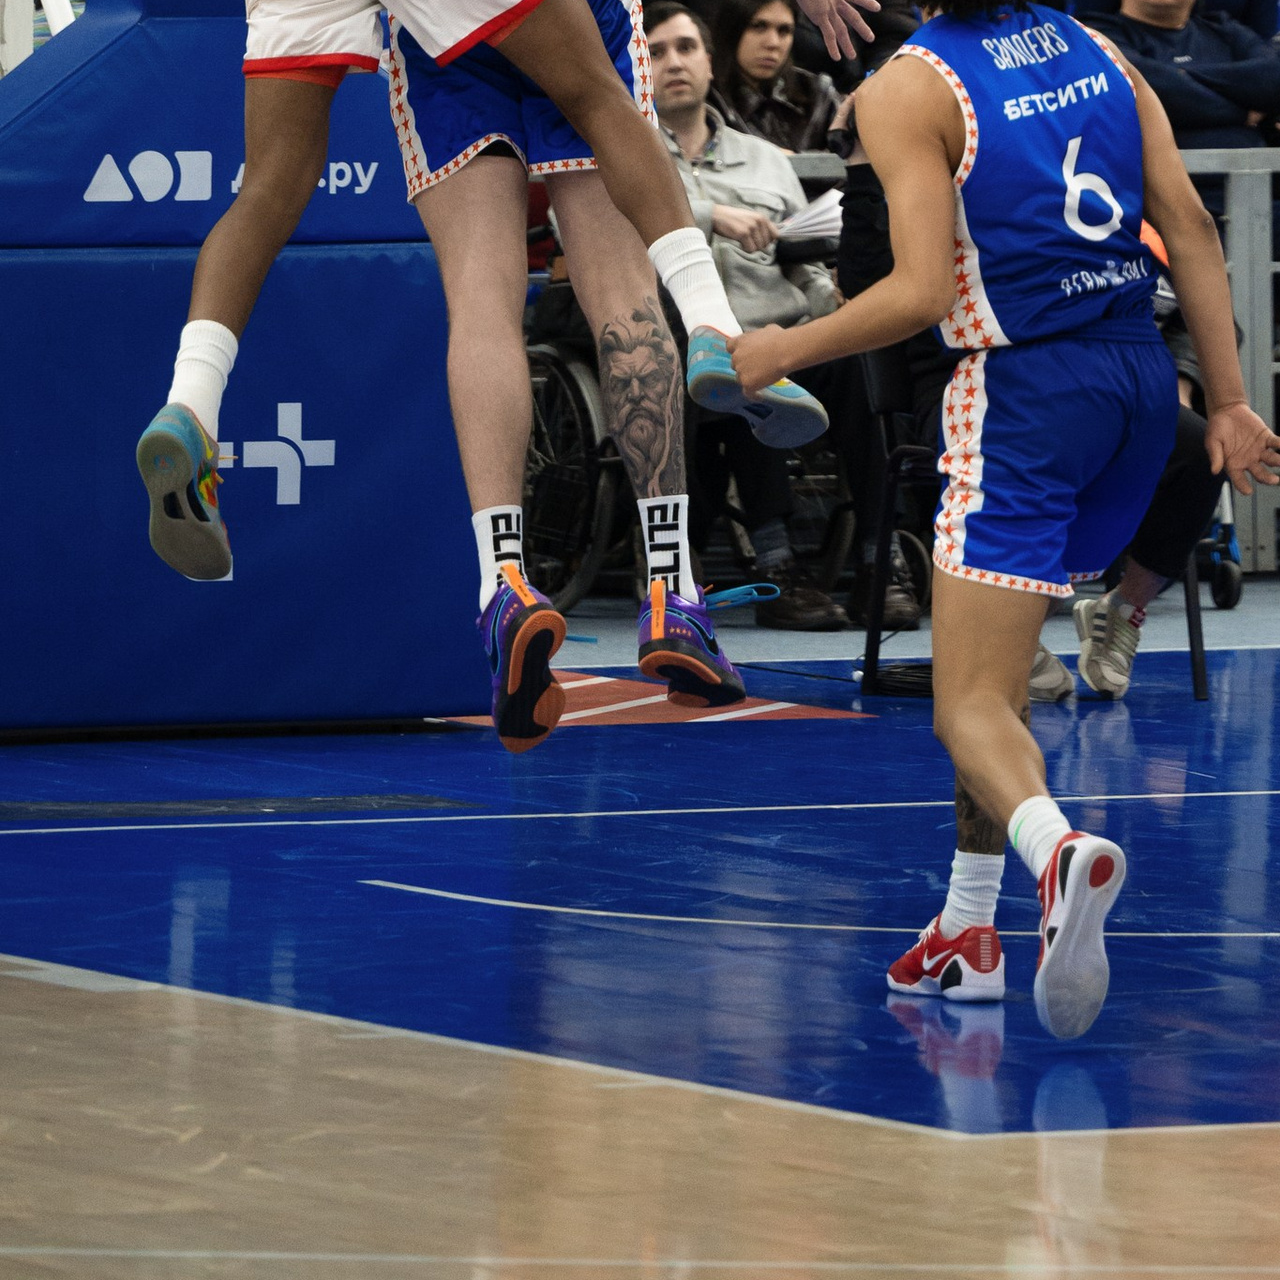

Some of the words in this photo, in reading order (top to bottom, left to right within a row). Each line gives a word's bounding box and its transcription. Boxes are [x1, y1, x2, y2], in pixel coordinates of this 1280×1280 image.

[981, 21, 1069, 72] SANDERS
[1003, 71, 1110, 122] БЕТСИТИ
[1061, 135, 1124, 242] 6
